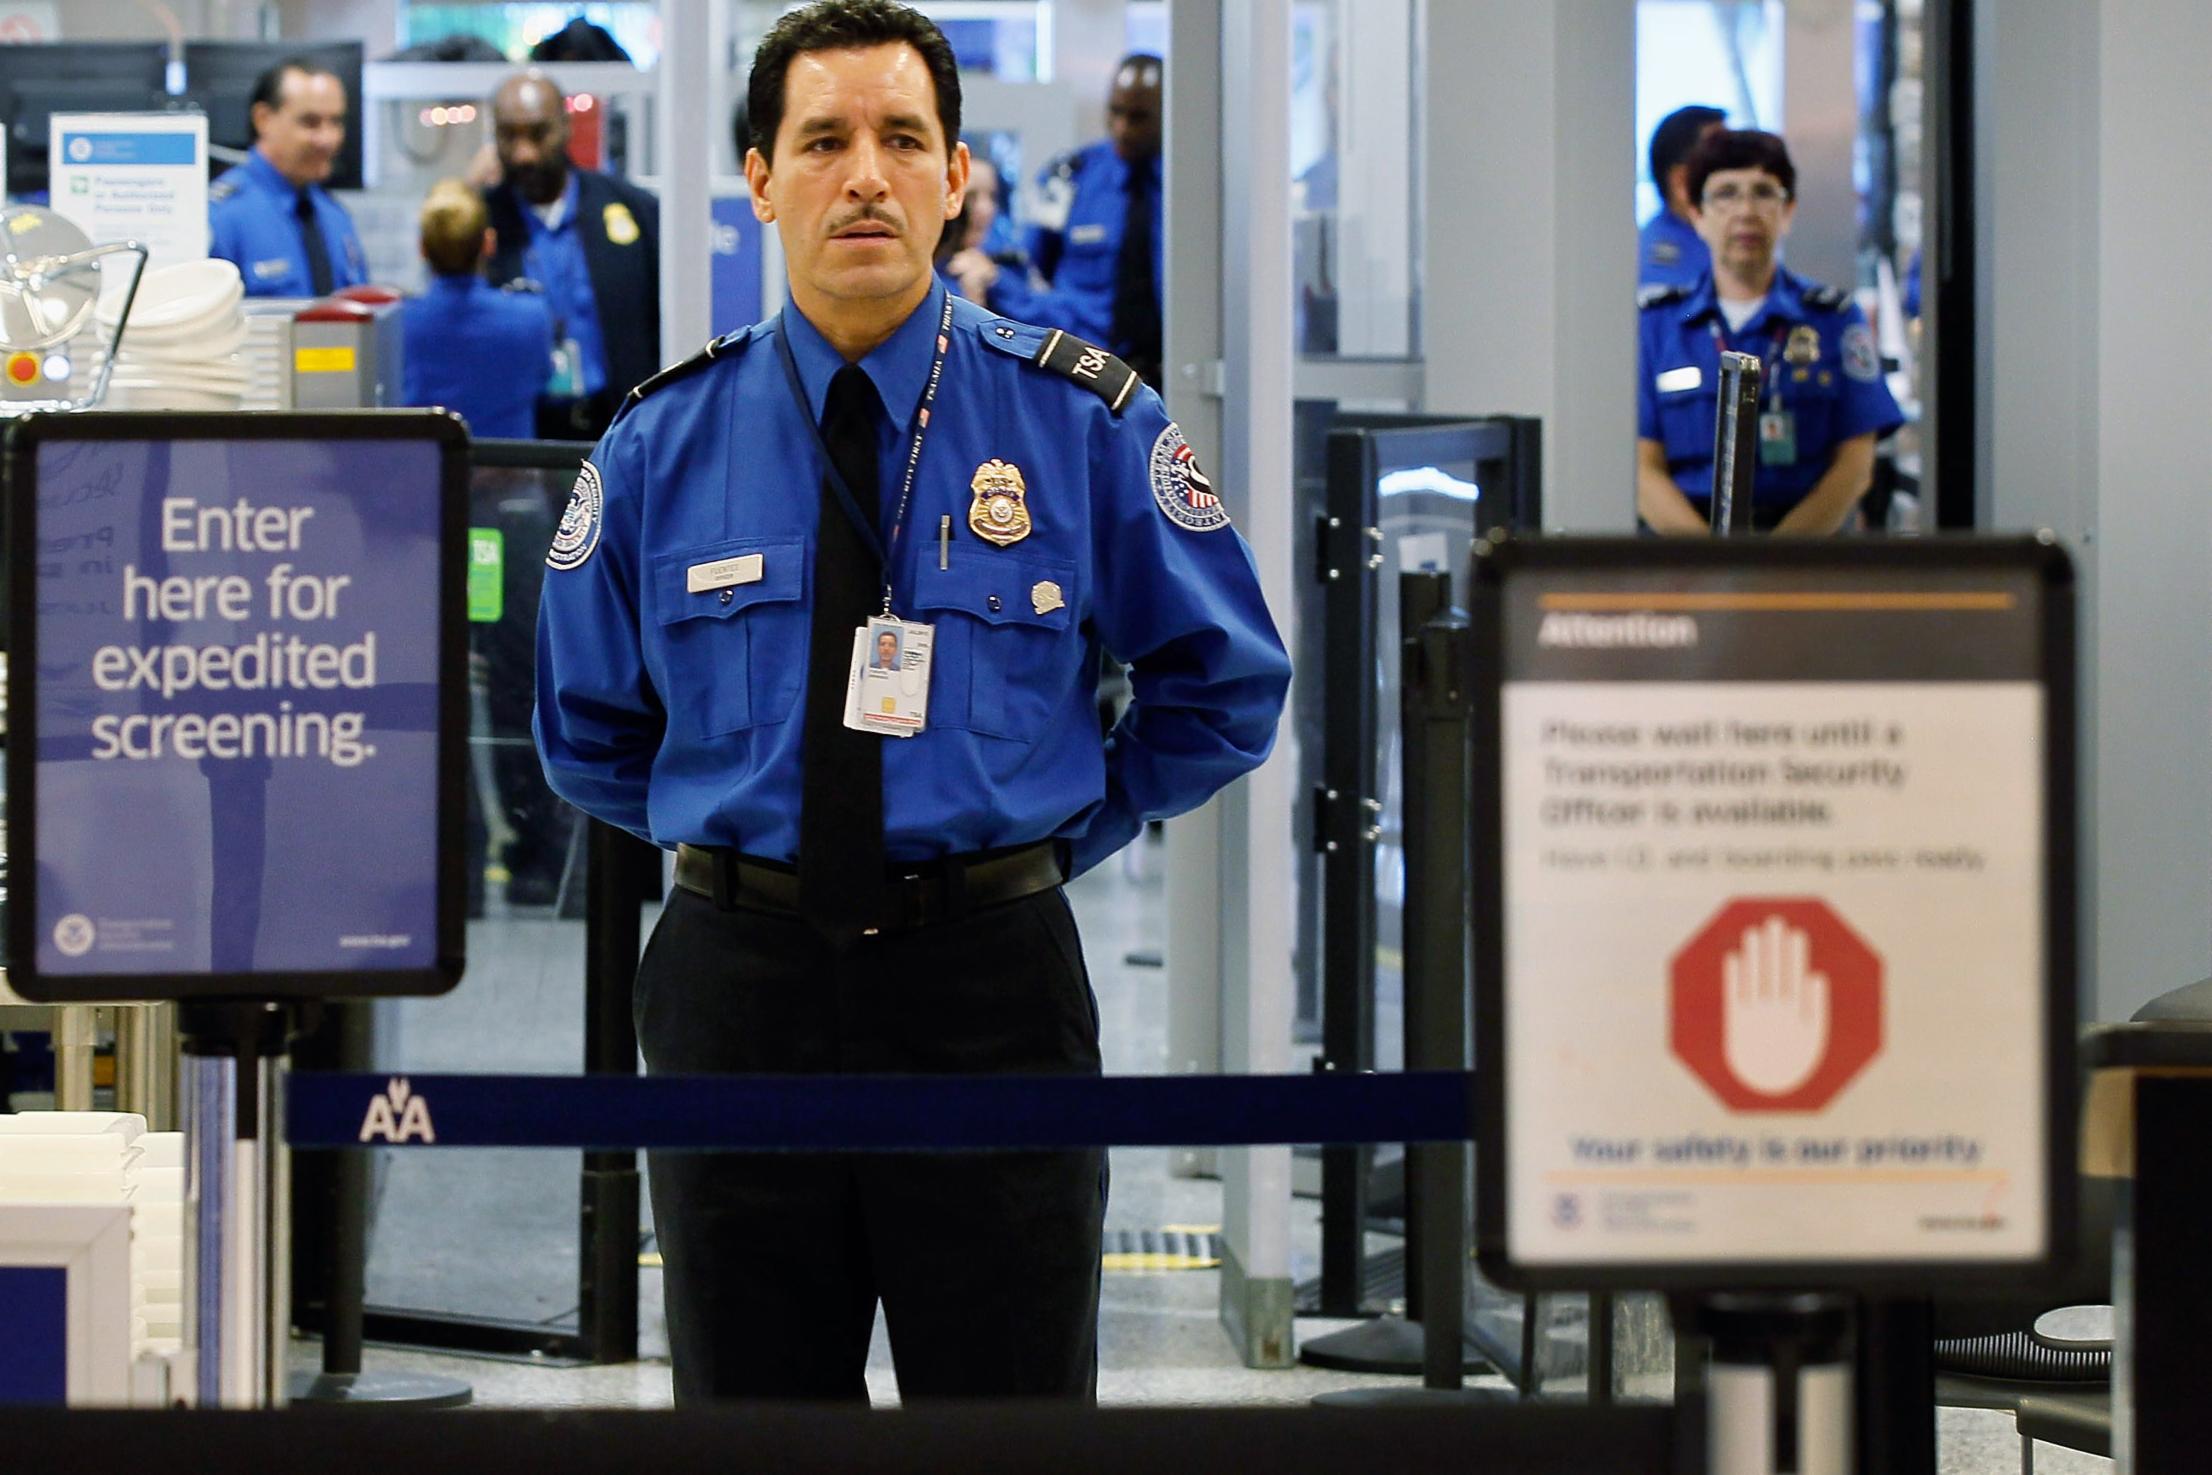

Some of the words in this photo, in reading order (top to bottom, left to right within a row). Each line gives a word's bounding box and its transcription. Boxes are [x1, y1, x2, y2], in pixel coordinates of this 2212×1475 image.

[1071, 346, 1111, 379] TSA
[161, 497, 313, 551] Enter
[123, 565, 251, 621] here
[267, 564, 350, 620] for
[1537, 611, 1698, 649] Attention
[92, 633, 377, 698] expedited
[91, 702, 377, 767] screening.
[1542, 718, 1640, 746] Please
[1655, 718, 1713, 746] wait
[1725, 718, 1793, 746] here
[1803, 718, 1872, 746] until
[1545, 757, 1767, 791] Transportation
[1783, 757, 1907, 792] Security
[1541, 796, 1644, 827] Officer
[1569, 1136, 1641, 1162] Your
[1653, 1134, 1751, 1170] safety
[1764, 1136, 1789, 1162] is
[1800, 1140, 1843, 1162] our
